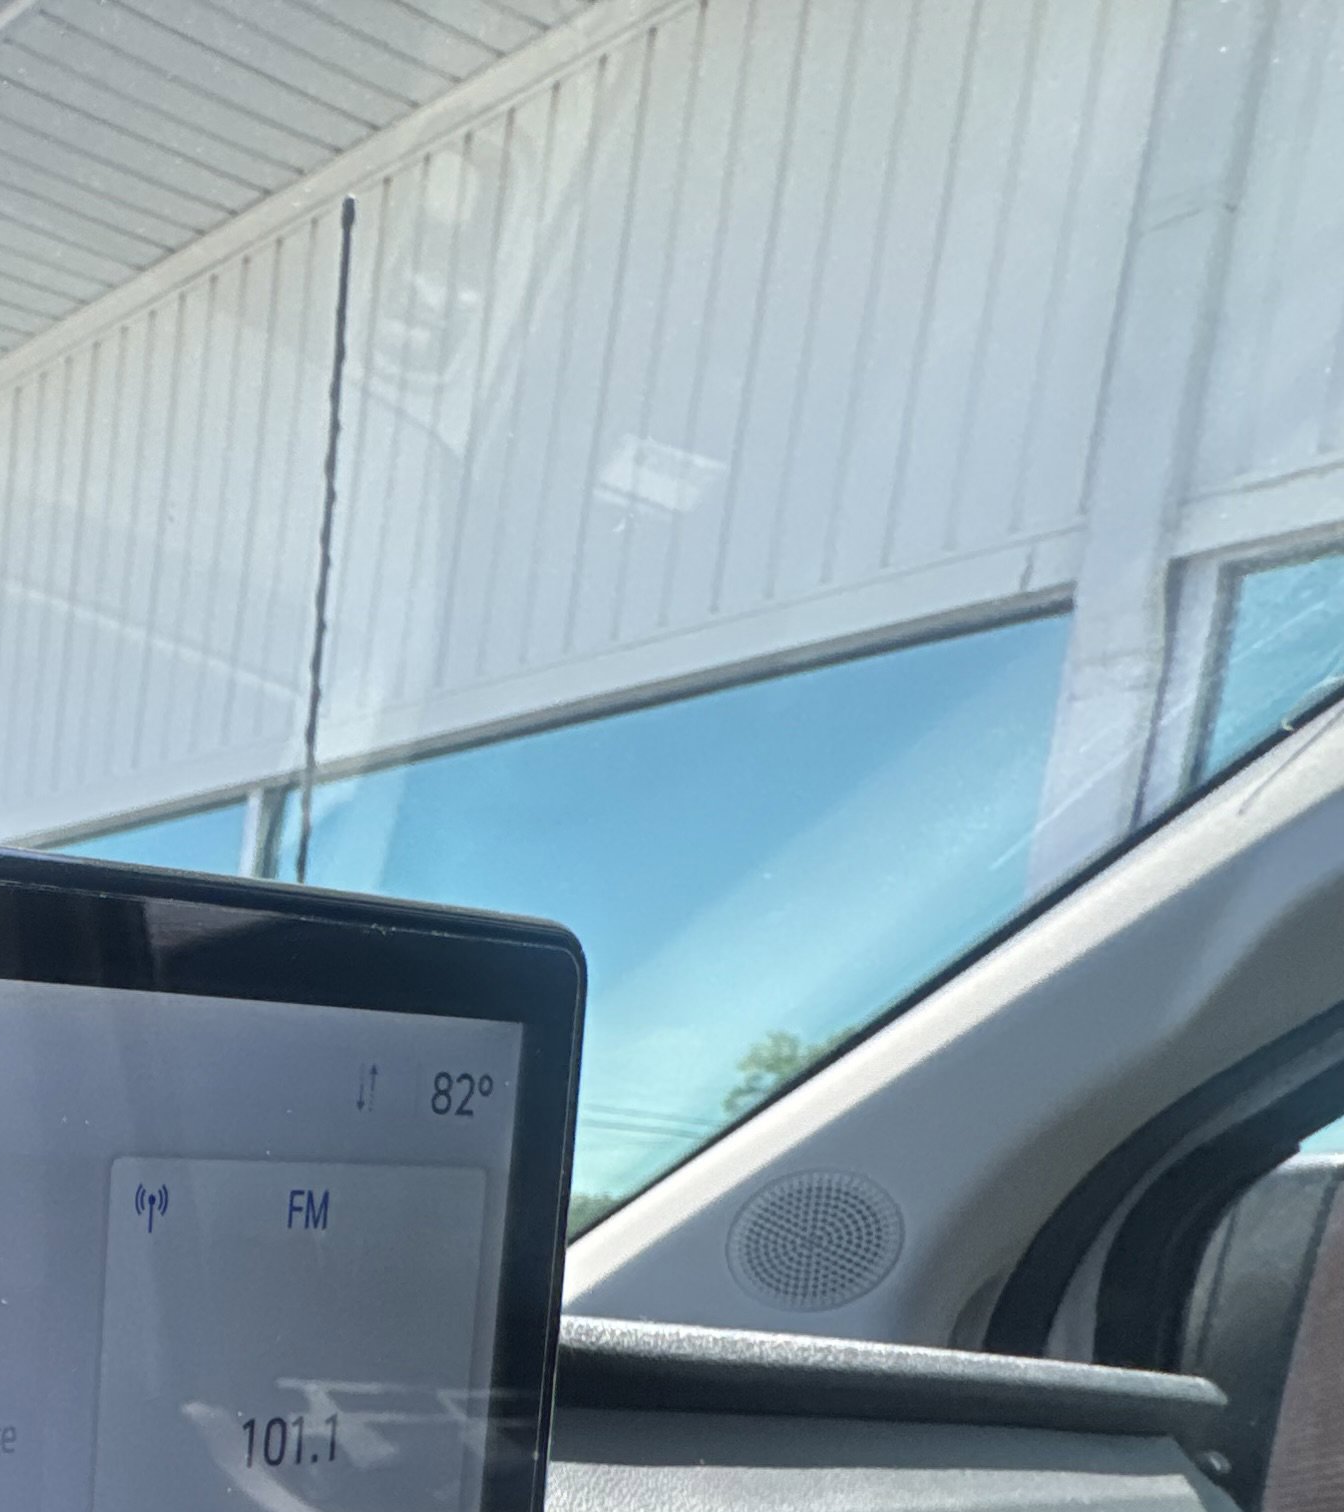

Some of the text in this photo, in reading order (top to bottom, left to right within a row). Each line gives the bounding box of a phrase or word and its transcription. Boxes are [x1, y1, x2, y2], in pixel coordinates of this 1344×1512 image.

[430, 1071, 494, 1116] 82°
[287, 1189, 330, 1230] FM
[241, 1413, 339, 1468] 101.1
